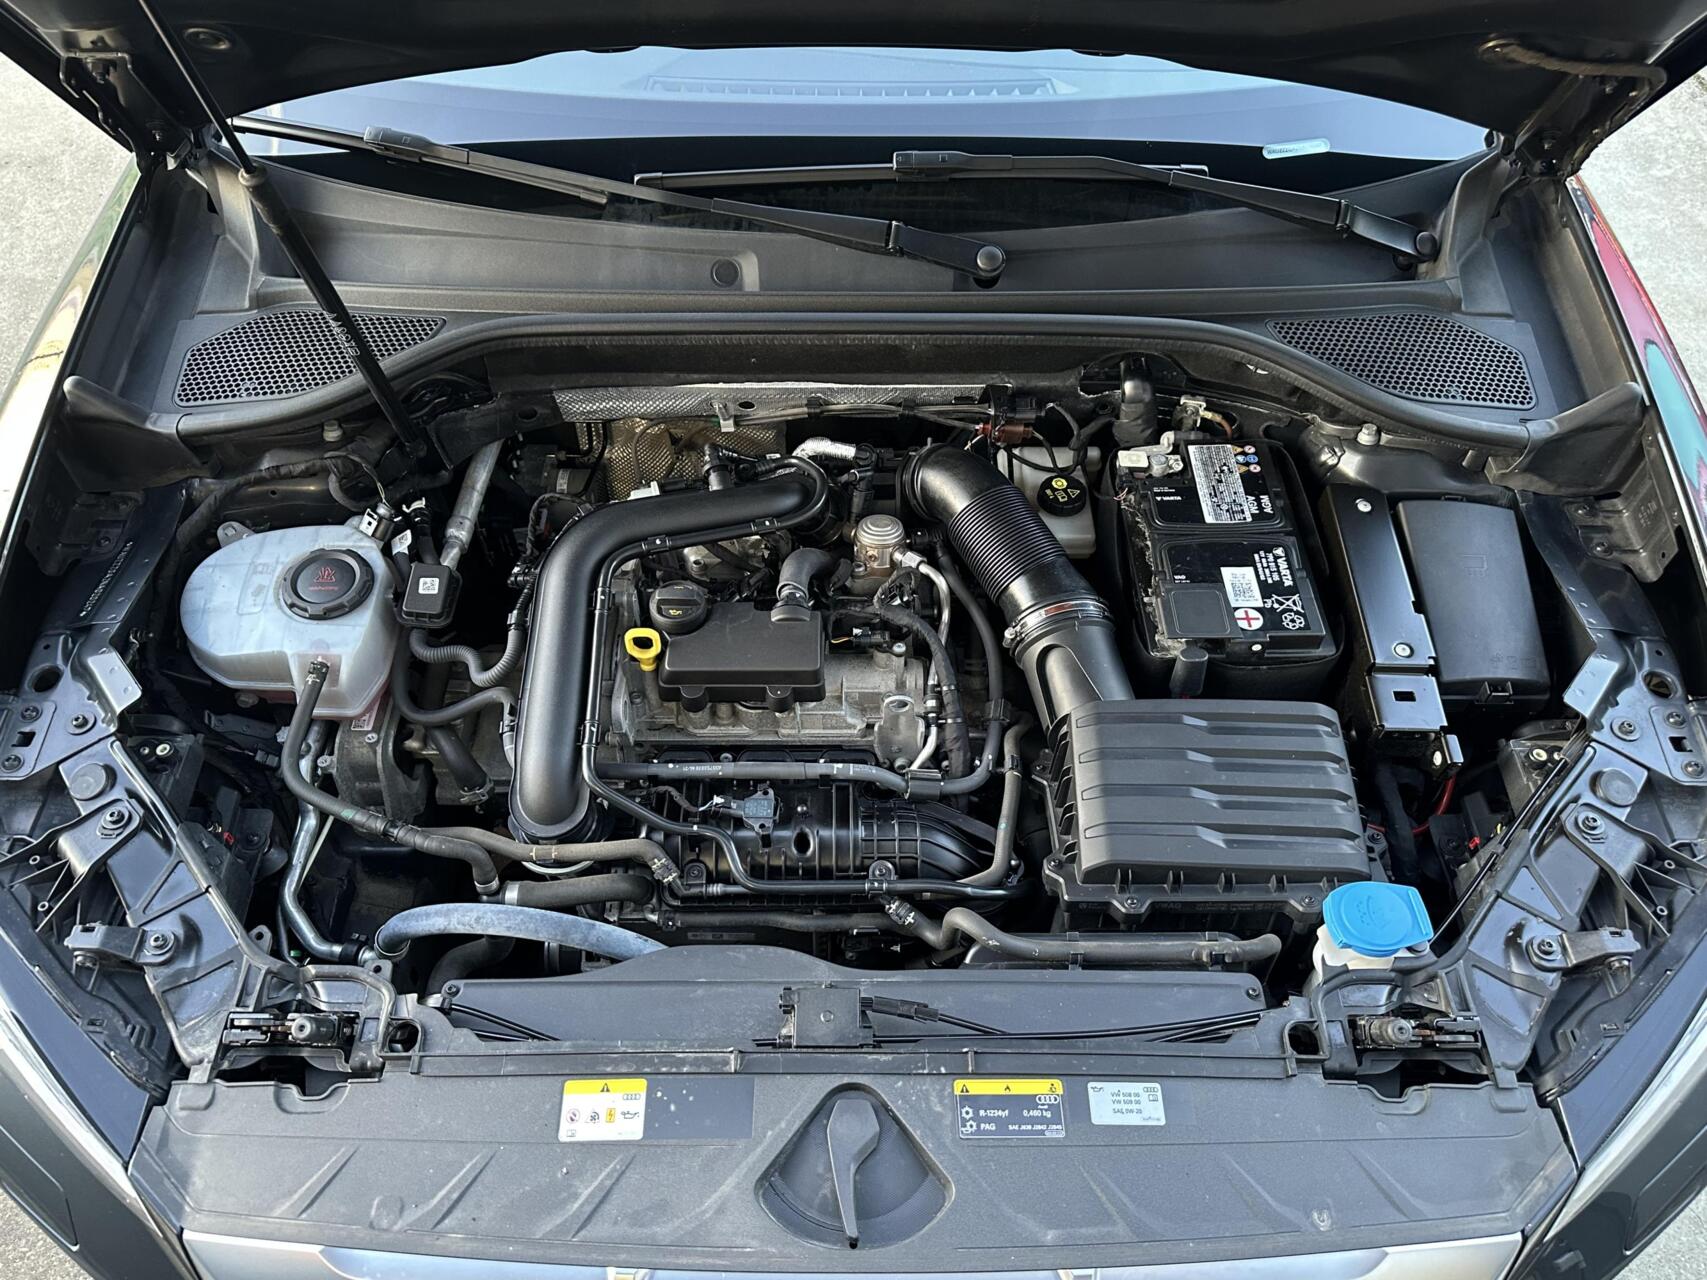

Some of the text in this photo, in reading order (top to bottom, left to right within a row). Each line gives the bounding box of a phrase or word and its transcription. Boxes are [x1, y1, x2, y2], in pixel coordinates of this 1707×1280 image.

[1247, 495, 1259, 514] AGM
[1260, 495, 1273, 514] AGM
[1276, 556, 1293, 587] VARTA
[979, 1109, 1008, 1118] R-1234yf
[1042, 1109, 1052, 1118] kg
